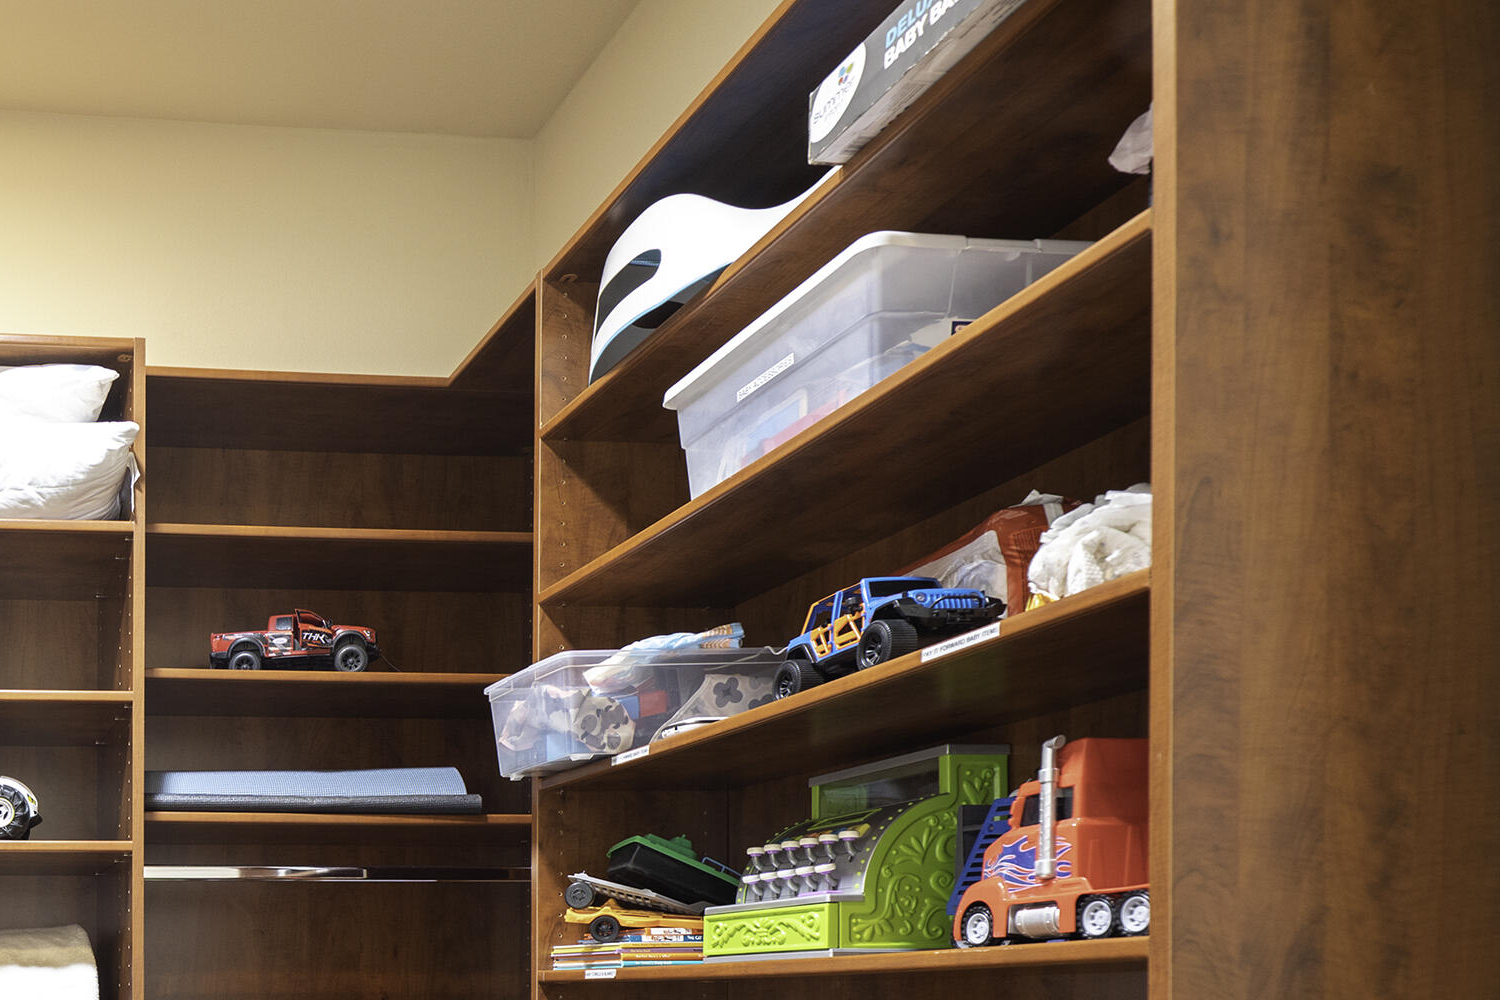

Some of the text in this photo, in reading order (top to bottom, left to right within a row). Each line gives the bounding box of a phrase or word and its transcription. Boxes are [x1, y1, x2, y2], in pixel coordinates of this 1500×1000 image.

[884, 0, 961, 70] BABY BA
[885, 0, 933, 49] DELU
